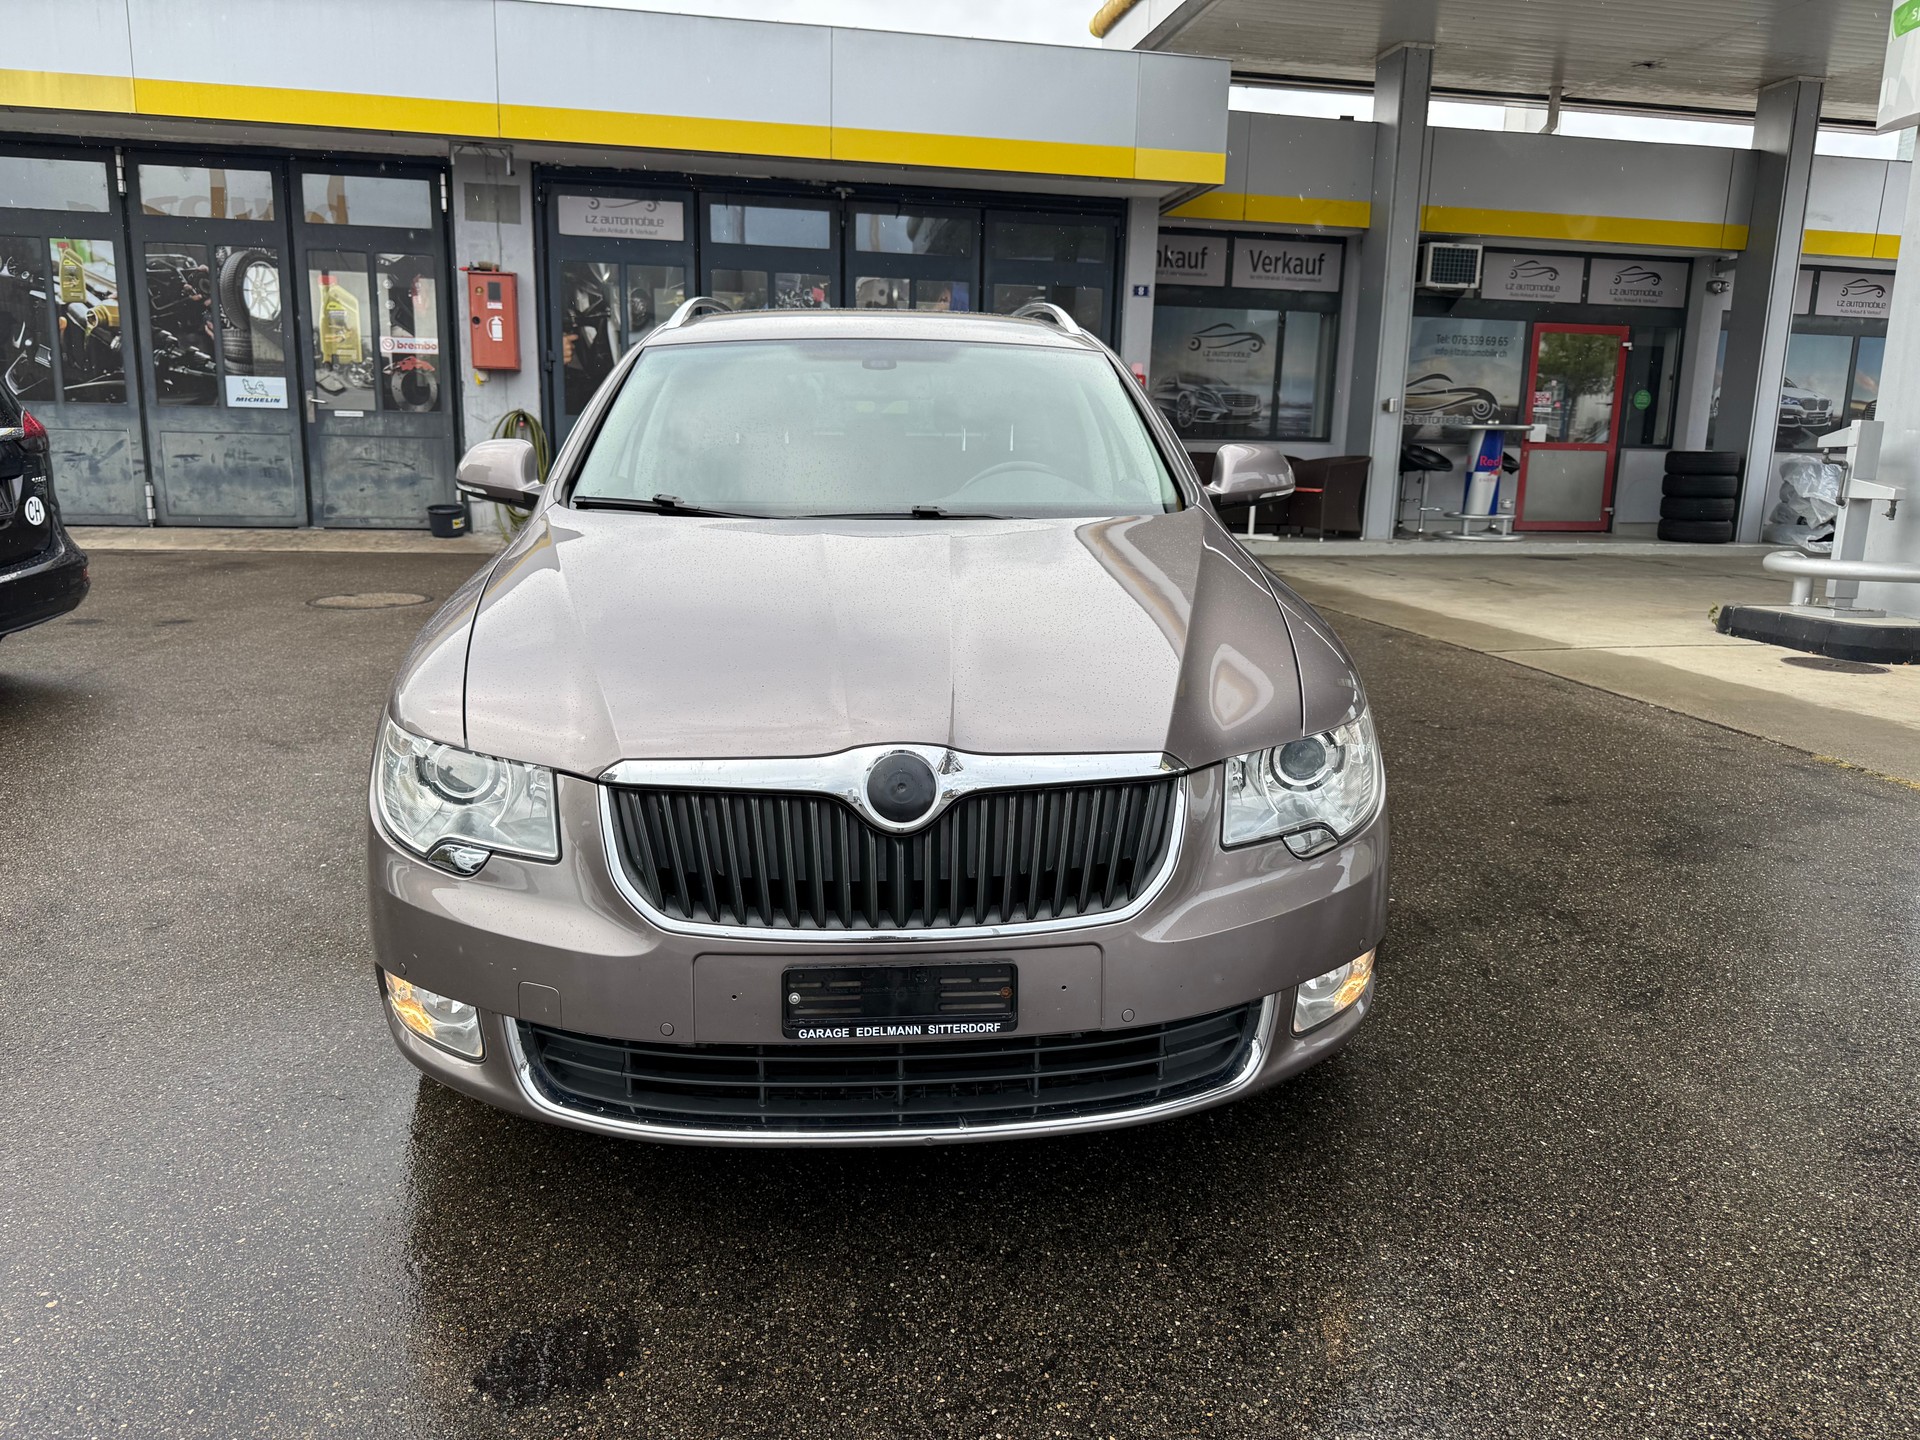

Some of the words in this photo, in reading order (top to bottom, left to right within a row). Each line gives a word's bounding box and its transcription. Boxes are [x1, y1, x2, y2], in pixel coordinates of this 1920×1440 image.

[585, 215, 598, 224] LZ
[600, 216, 665, 227] automobile
[1156, 245, 1208, 270] nkauf
[1249, 249, 1326, 276] Verkauf
[1138, 286, 1145, 296] 8
[1516, 284, 1560, 293] automobile
[1620, 289, 1664, 297] automobile
[1846, 300, 1887, 309] automobile
[397, 340, 437, 350] brembo
[1451, 335, 1467, 345] 076
[1468, 335, 1485, 346] 339
[1485, 336, 1497, 346] 69
[1498, 336, 1509, 347] 65
[1480, 455, 1502, 466] Red
[28, 500, 42, 521] CH
[798, 1028, 850, 1039] GARAGE
[856, 1025, 922, 1037] EDELMANN
[927, 1023, 1001, 1035] SITTERDORF
